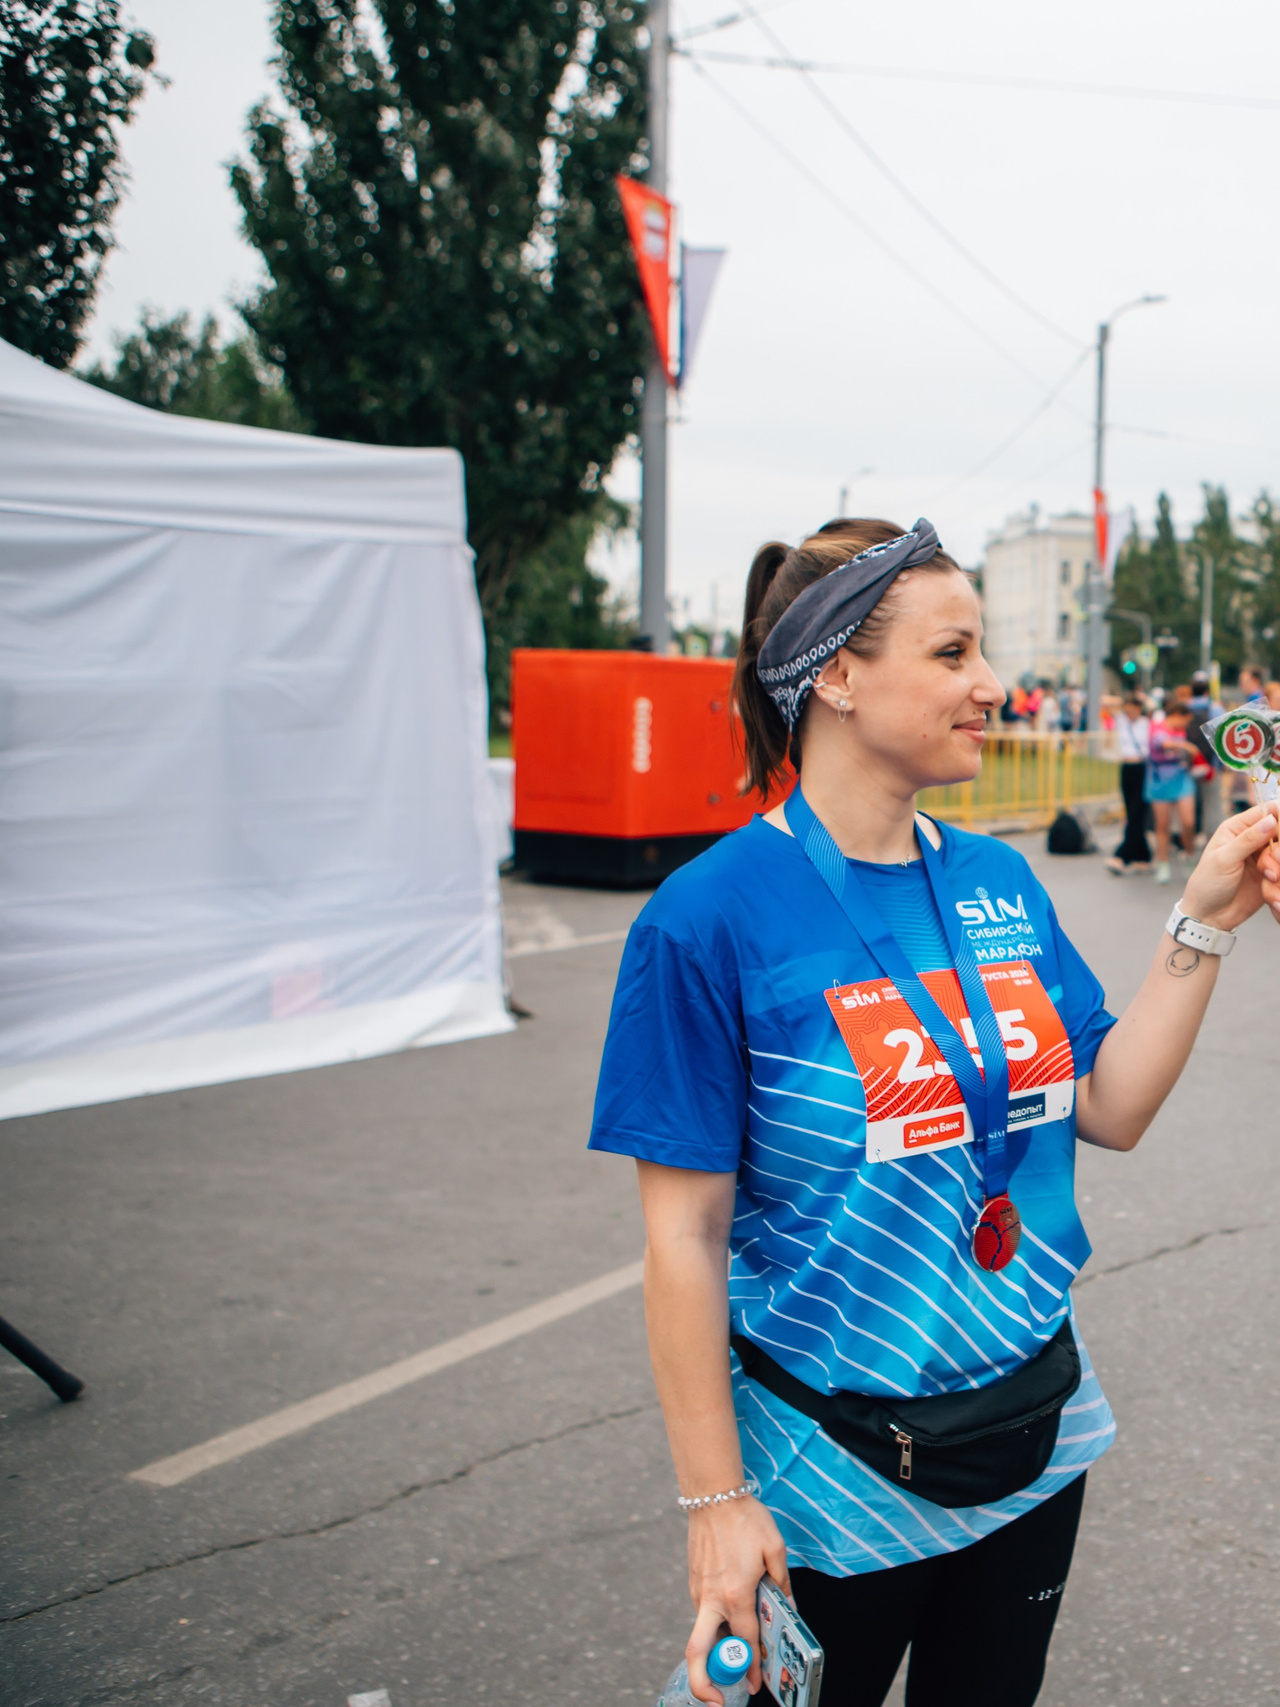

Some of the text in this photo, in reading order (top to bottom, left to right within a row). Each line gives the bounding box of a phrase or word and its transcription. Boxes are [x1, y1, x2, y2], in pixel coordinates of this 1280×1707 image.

[1234, 726, 1255, 755] 5
[971, 935, 1039, 948] МЕЖДУНАРО
[982, 971, 1010, 982] ГУСТА
[908, 1121, 960, 1142] Альфа Банк
